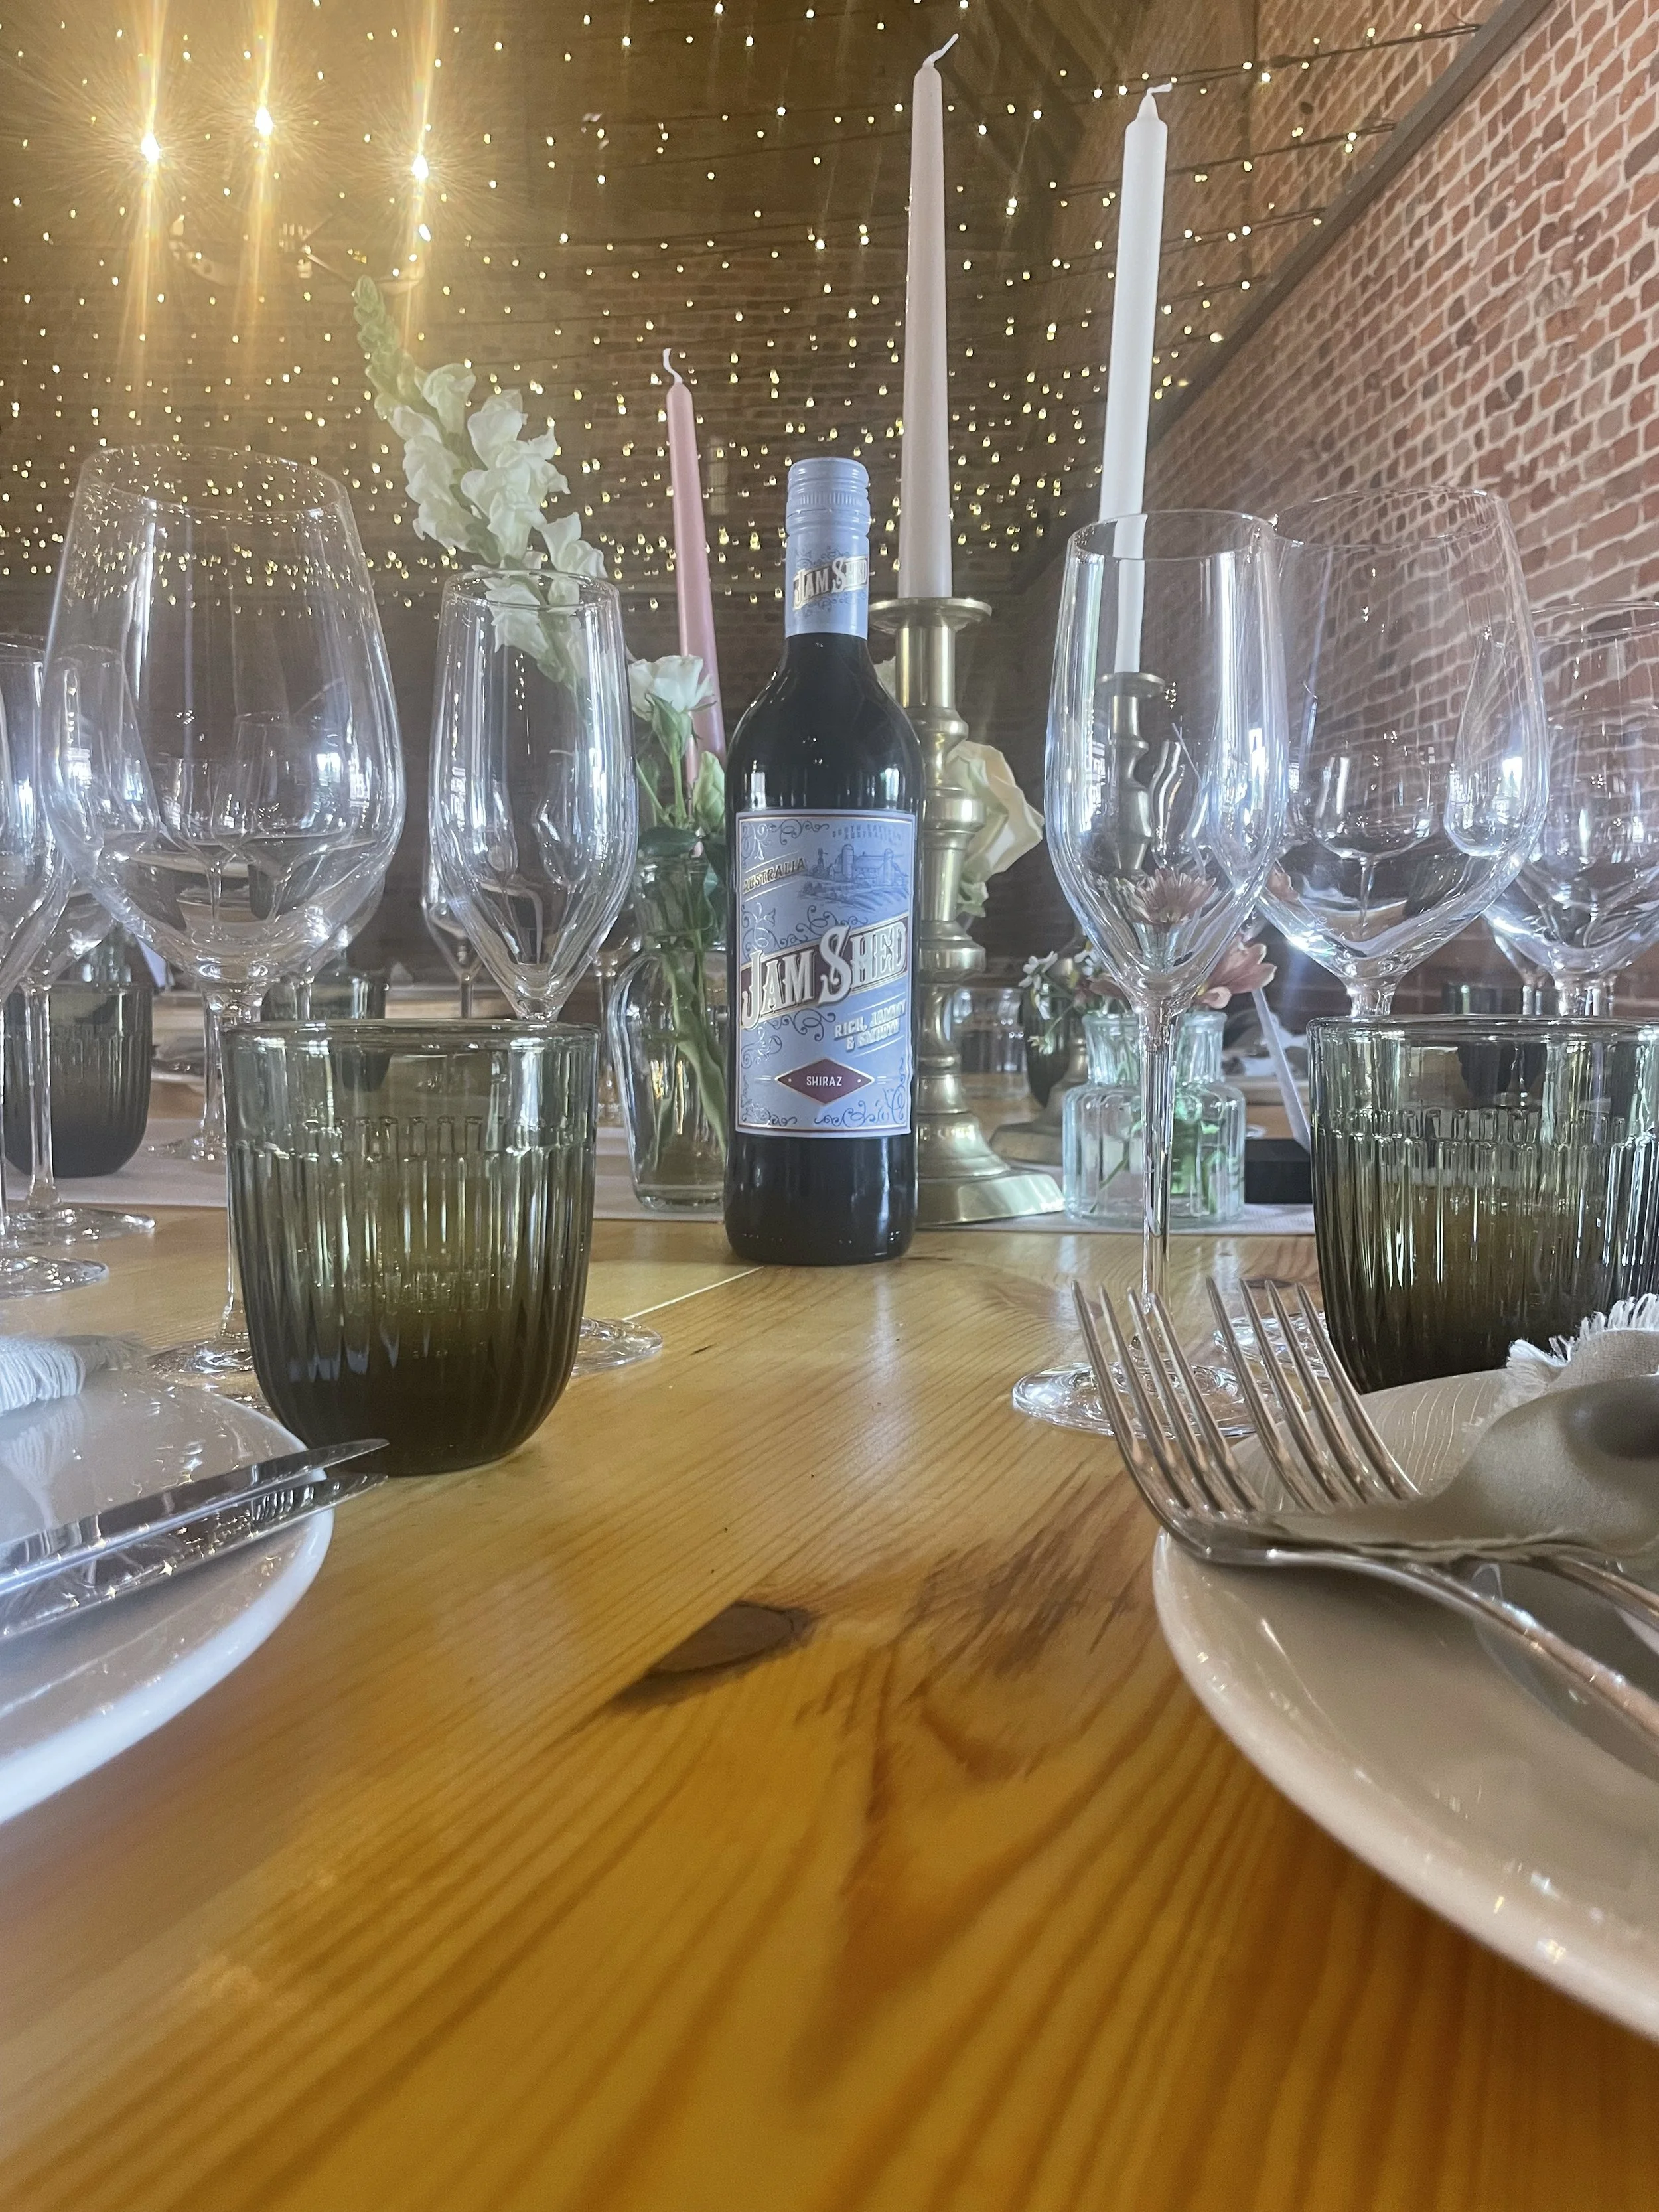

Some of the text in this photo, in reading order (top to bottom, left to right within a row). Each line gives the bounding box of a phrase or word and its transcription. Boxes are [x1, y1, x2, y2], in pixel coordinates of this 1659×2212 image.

[793, 568, 828, 608] JAM
[867, 824, 901, 841] EAST
[743, 857, 805, 891] AUSTRALIA
[741, 924, 907, 1028] JAM SHED
[834, 1016, 867, 1039] RICH,
[846, 1036, 855, 1051] &
[806, 1076, 843, 1087] SHIRAZ
